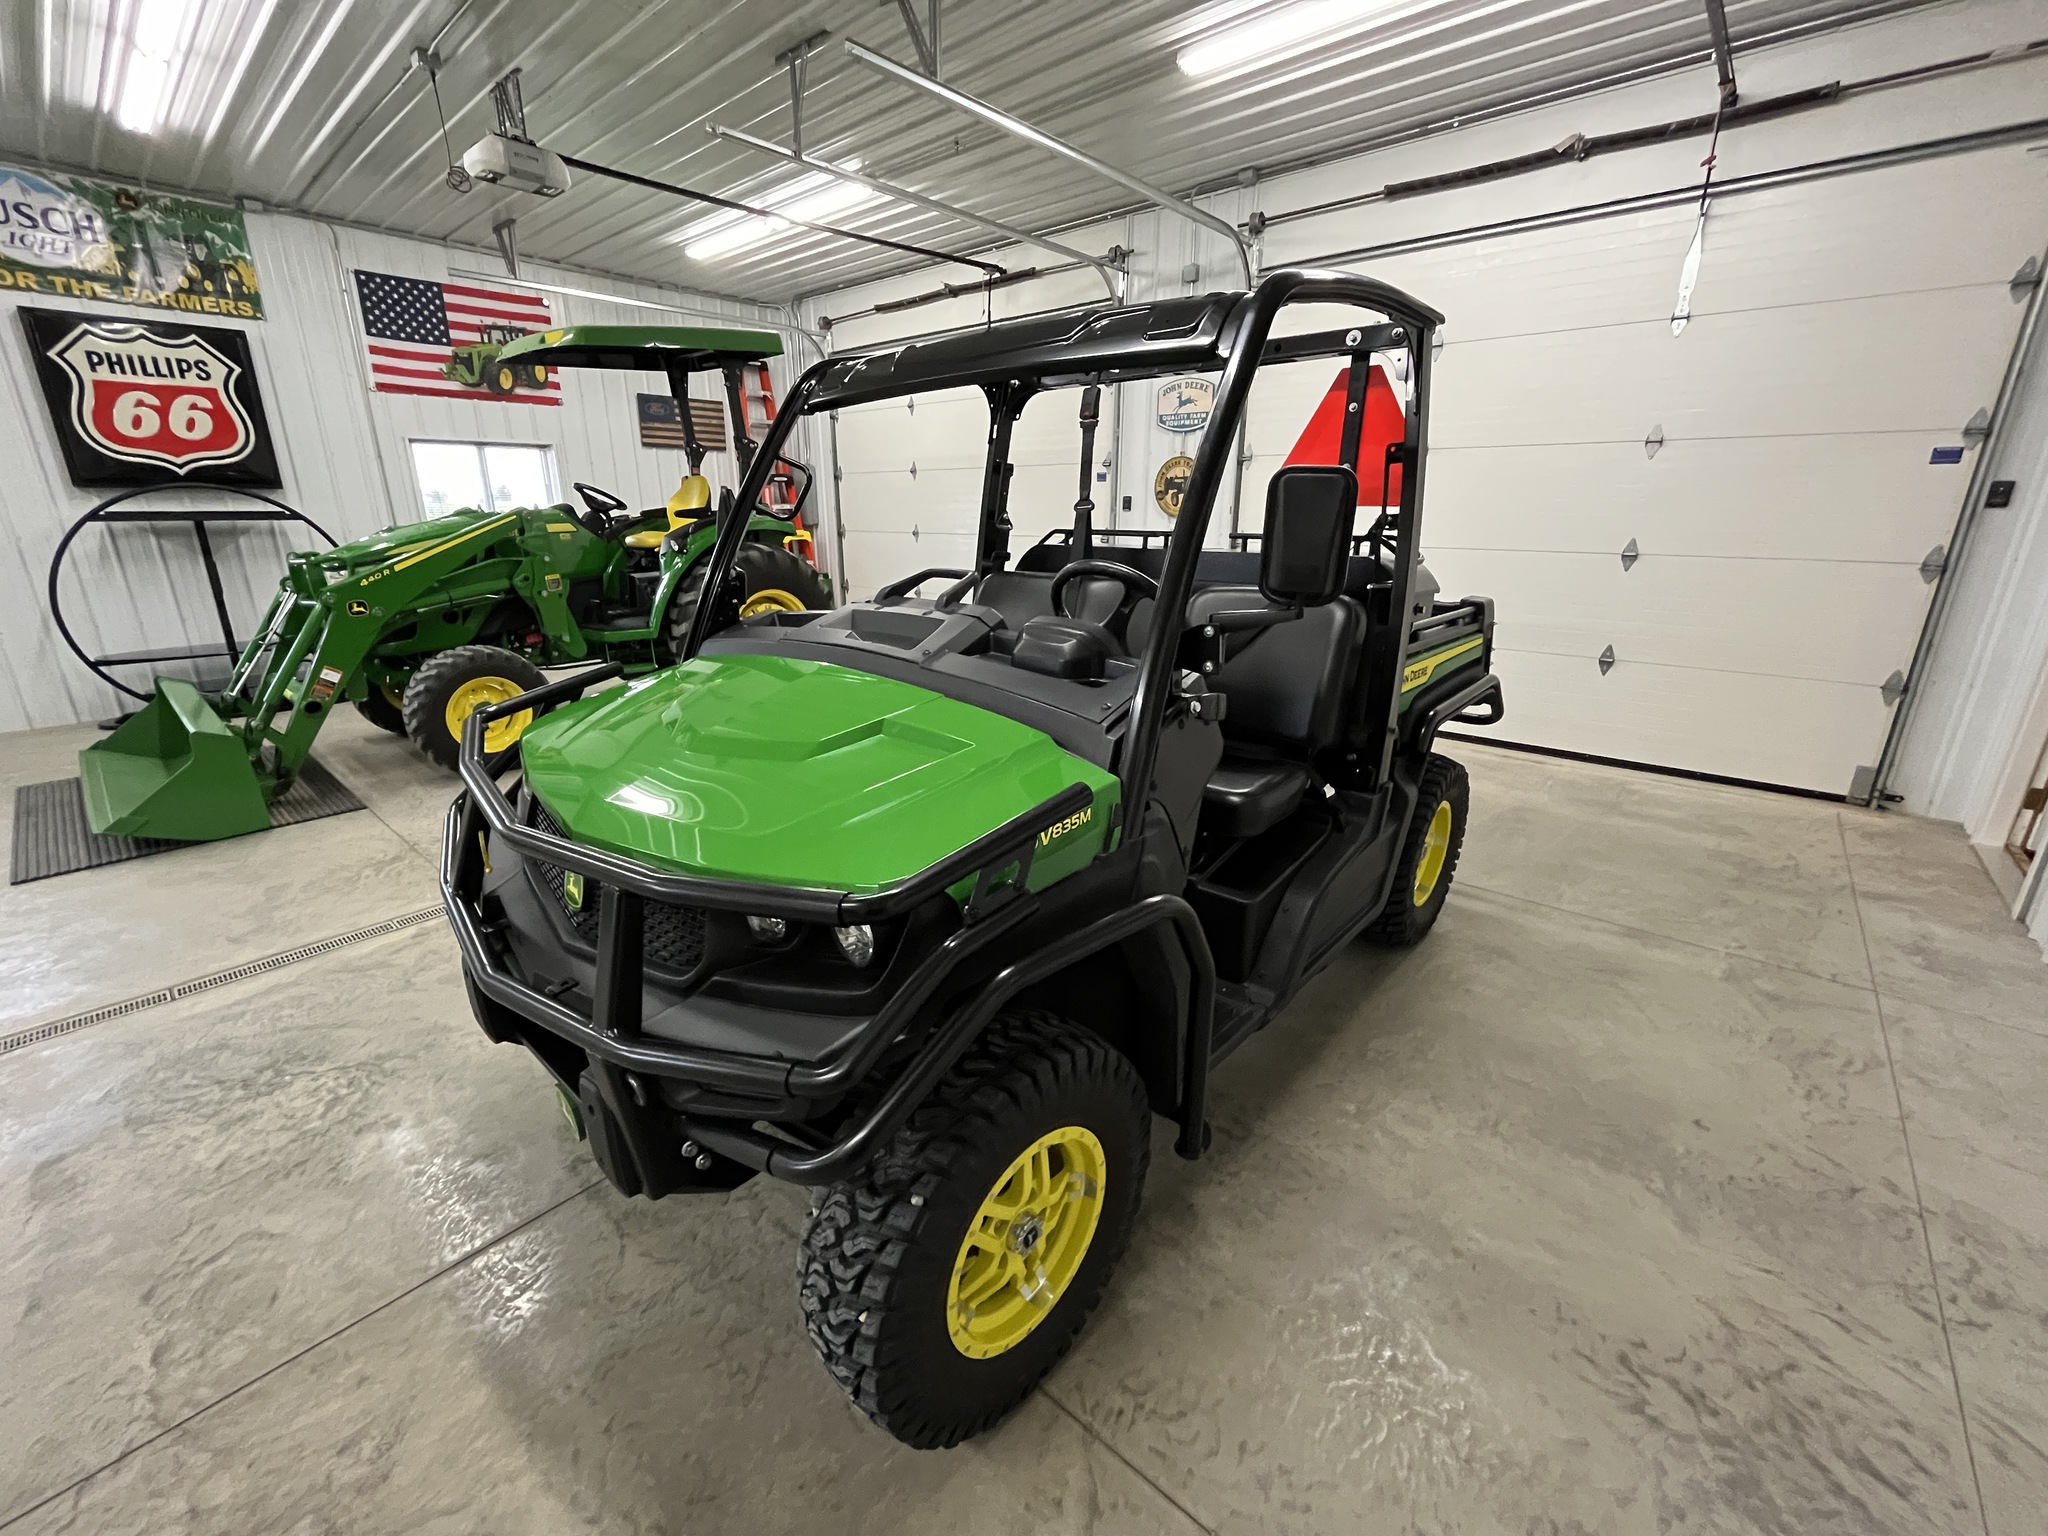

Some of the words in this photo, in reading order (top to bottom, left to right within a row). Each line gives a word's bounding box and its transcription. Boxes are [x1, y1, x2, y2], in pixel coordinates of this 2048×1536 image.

[47, 275, 118, 299] THE
[84, 350, 212, 381] PHILLIPS
[1163, 383, 1181, 396] JOHN
[1185, 381, 1209, 393] DEERE
[112, 390, 214, 440] 66
[1162, 413, 1187, 421] QUALITY
[360, 573, 382, 586] 440
[1410, 666, 1428, 682] DEERE
[1034, 808, 1093, 849] V835M
